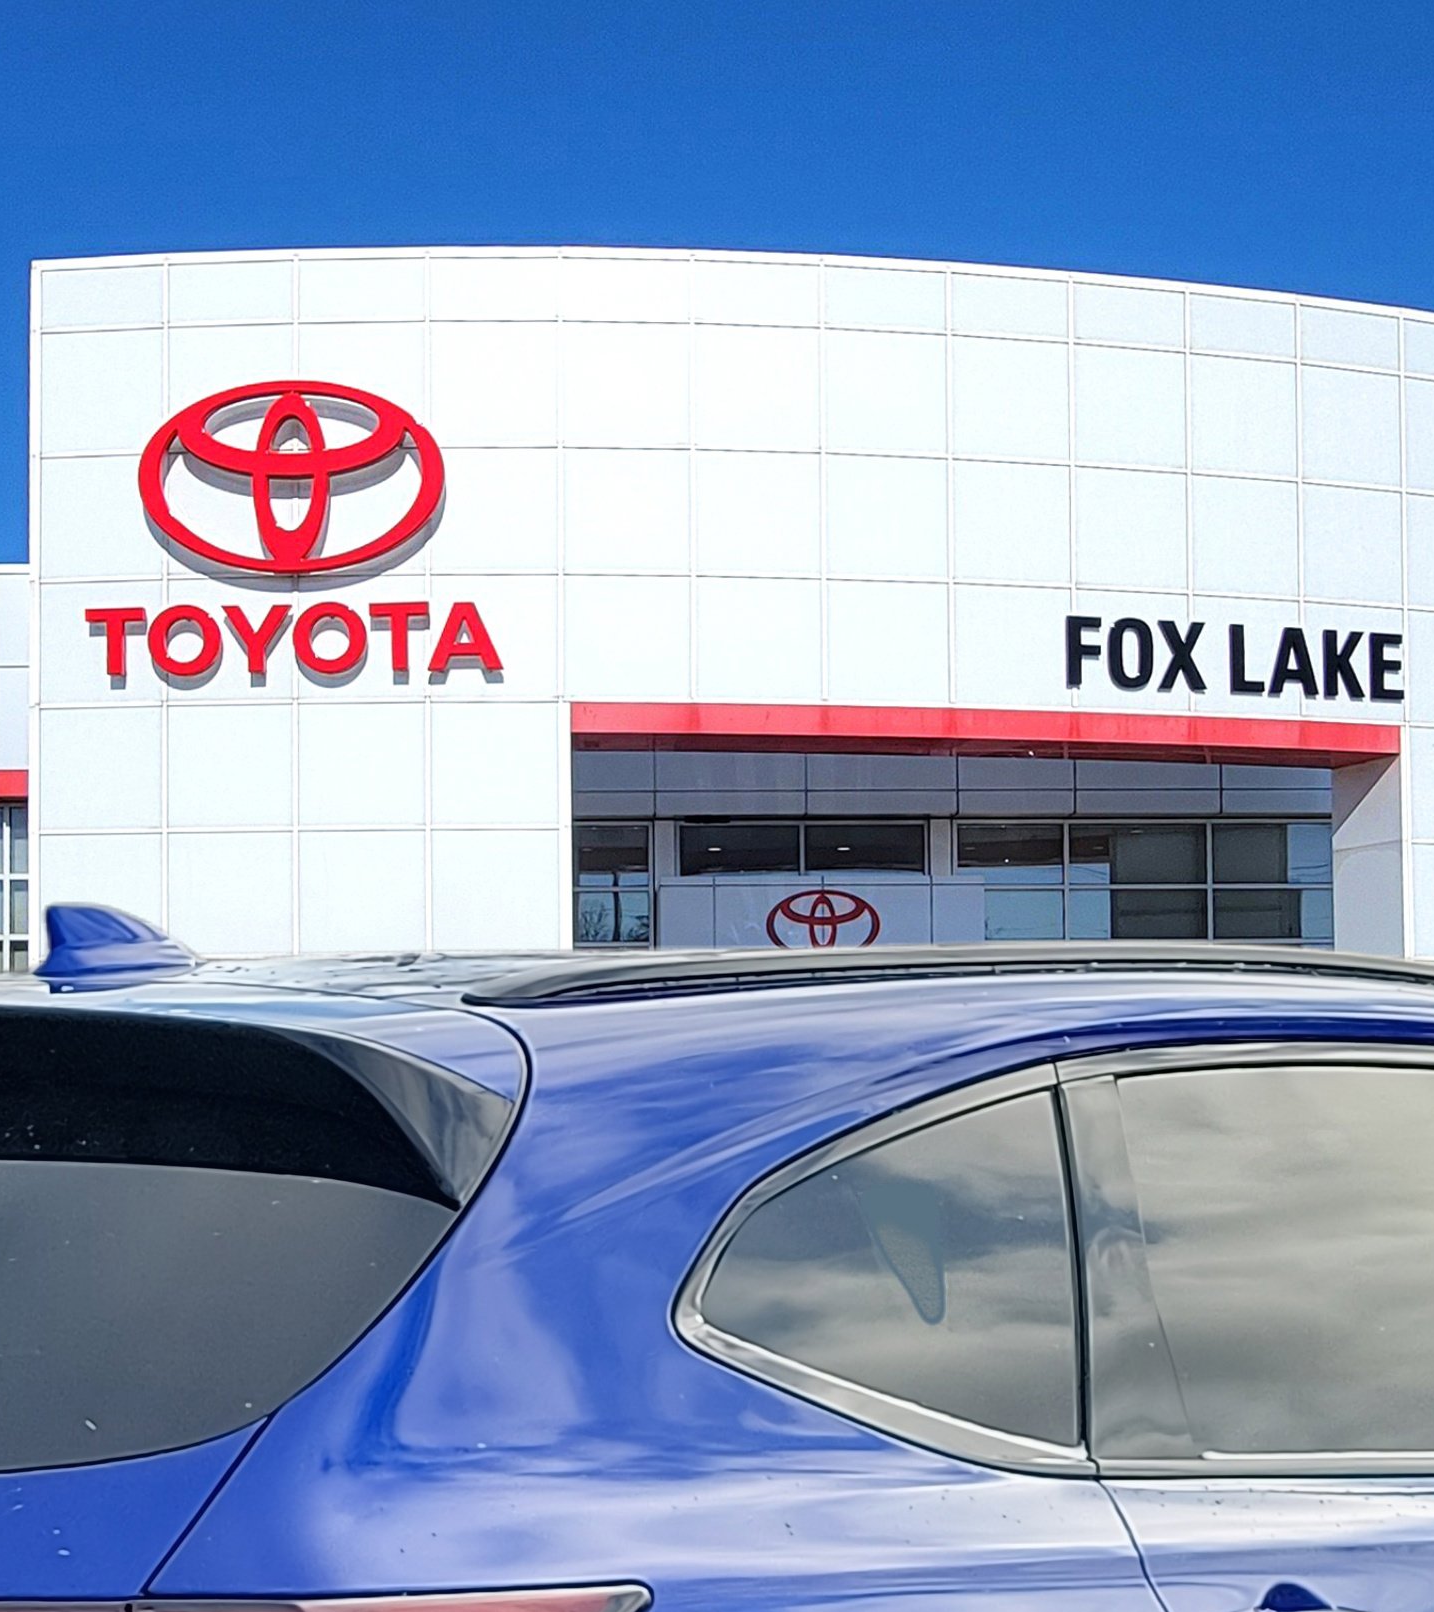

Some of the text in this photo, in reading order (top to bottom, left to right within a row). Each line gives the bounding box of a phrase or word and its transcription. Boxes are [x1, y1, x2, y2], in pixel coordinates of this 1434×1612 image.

[85, 602, 503, 677] TOYOTA
[1066, 615, 1405, 701] FOX LAKE
